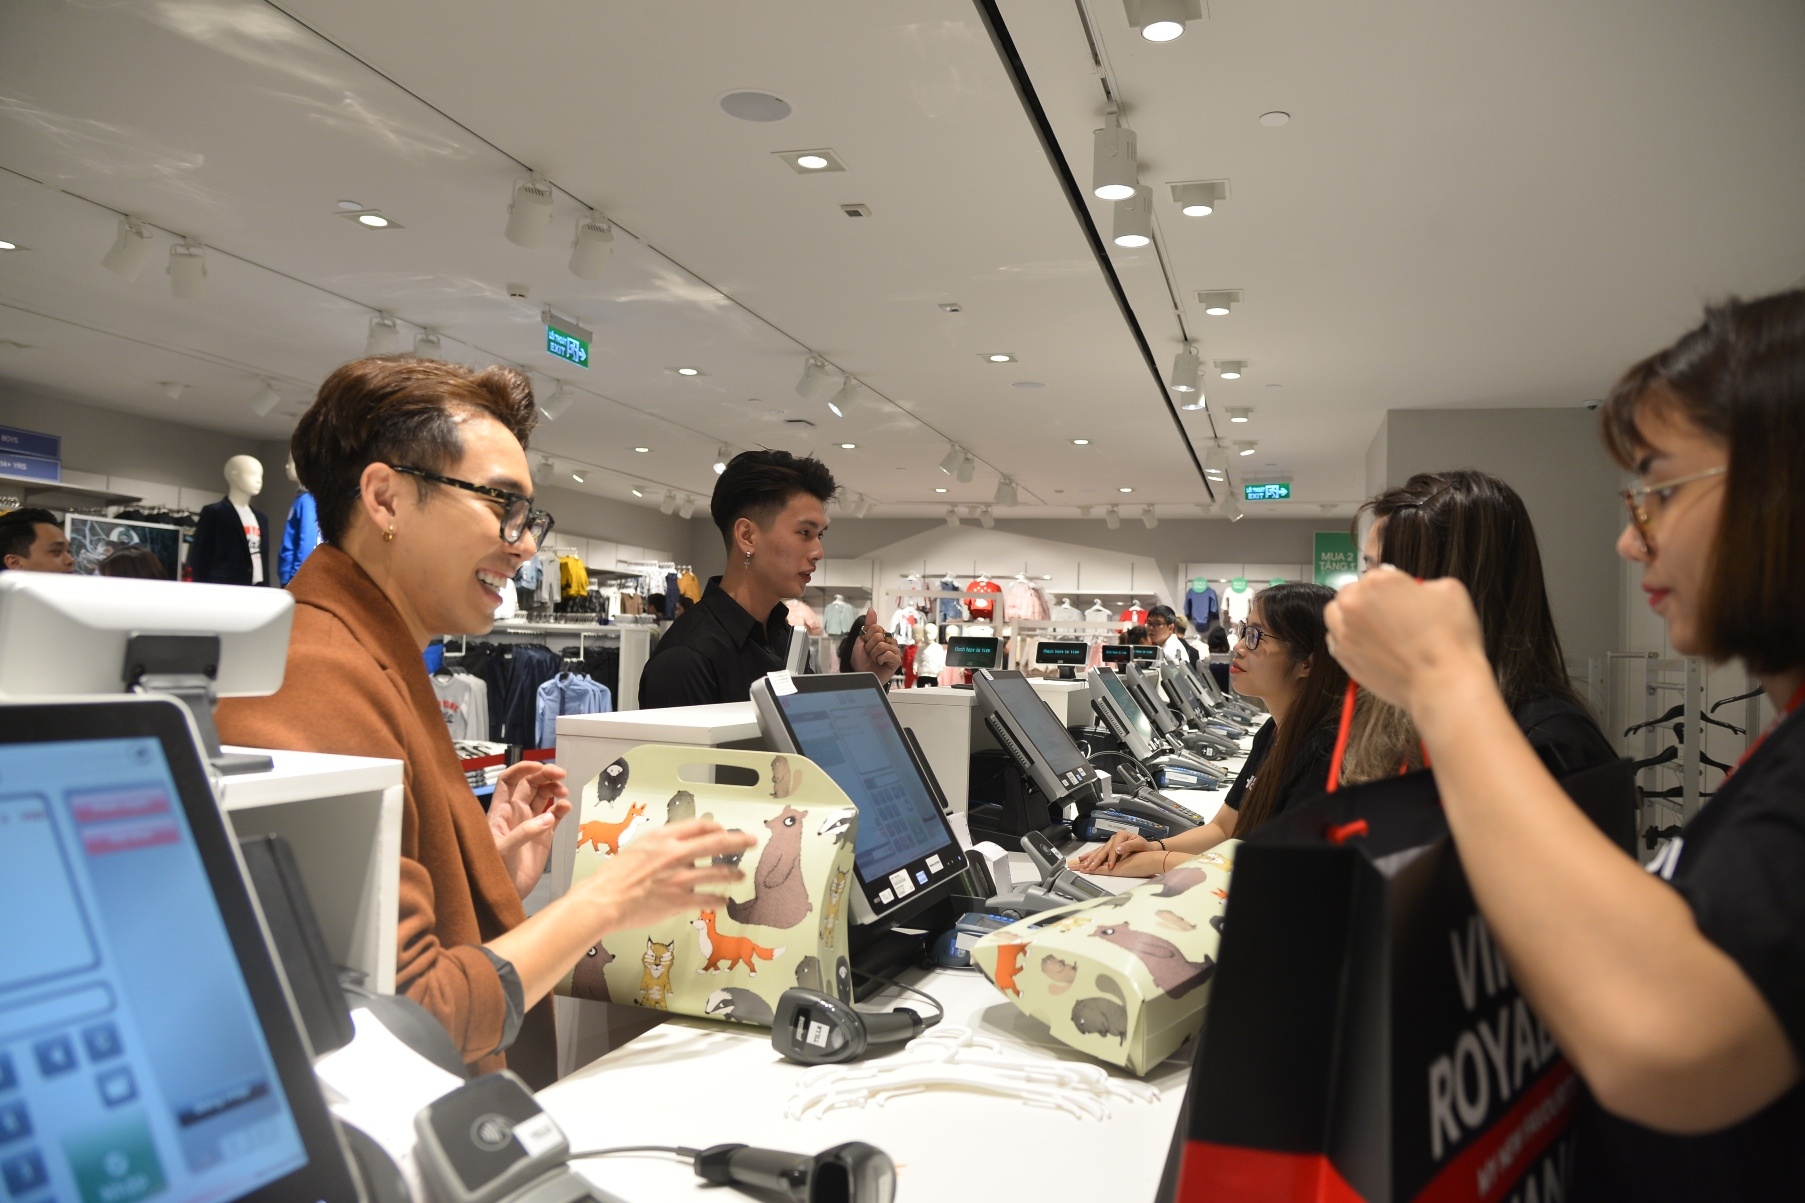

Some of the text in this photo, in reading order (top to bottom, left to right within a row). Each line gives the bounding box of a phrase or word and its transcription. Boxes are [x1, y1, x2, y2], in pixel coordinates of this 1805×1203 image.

[550, 342, 565, 355] EXIT
[12, 462, 28, 471] YRS
[1321, 552, 1354, 561] MUA 2
